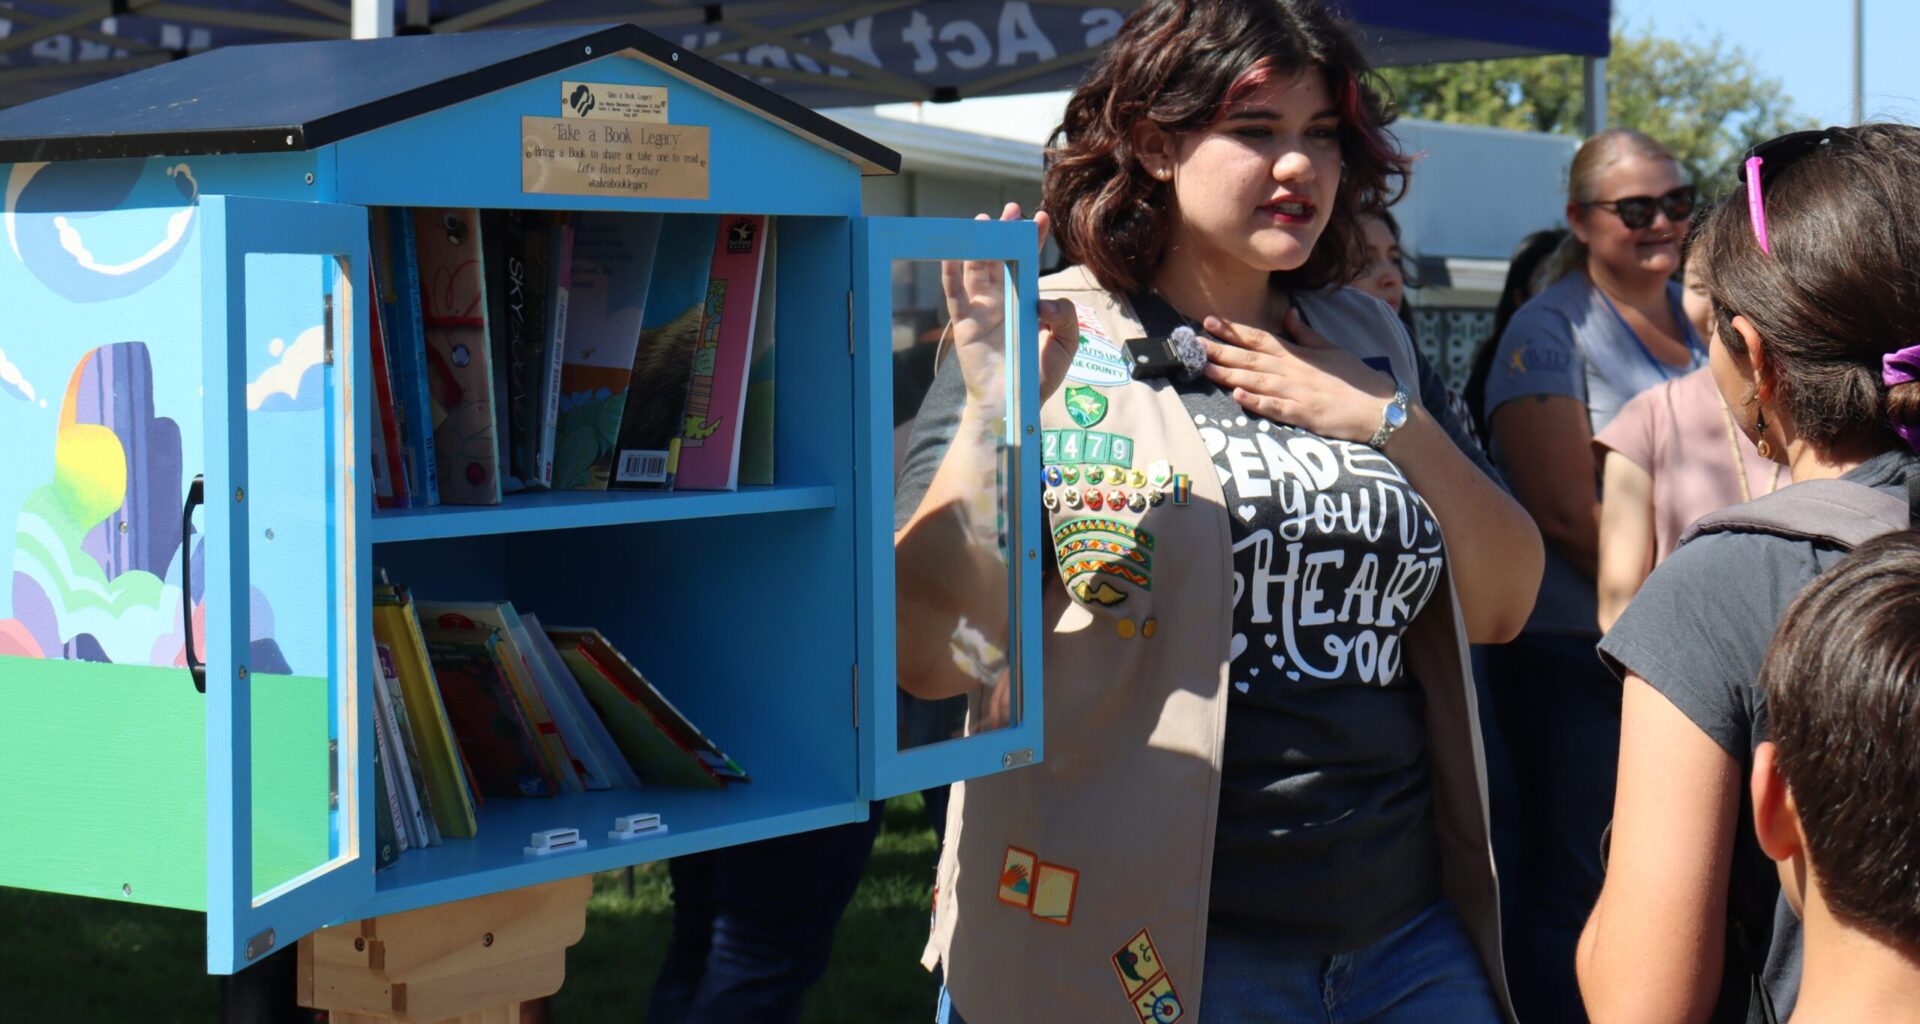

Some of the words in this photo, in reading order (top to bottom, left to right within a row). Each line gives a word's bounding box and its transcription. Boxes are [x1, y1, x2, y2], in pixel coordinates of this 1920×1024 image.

[588, 131, 596, 143] a
[604, 126, 632, 144] Book
[534, 146, 555, 158] Bring
[568, 147, 586, 159] Book
[590, 149, 599, 159] to
[602, 149, 622, 160] share
[625, 152, 634, 161] or
[637, 150, 652, 161] take
[656, 153, 669, 162] one
[672, 151, 680, 163] to
[683, 152, 699, 164] read
[600, 163, 621, 175] Read
[625, 164, 661, 178] Together
[1086, 362, 1123, 378] COUNTY
[1046, 433, 1126, 461] 2479
